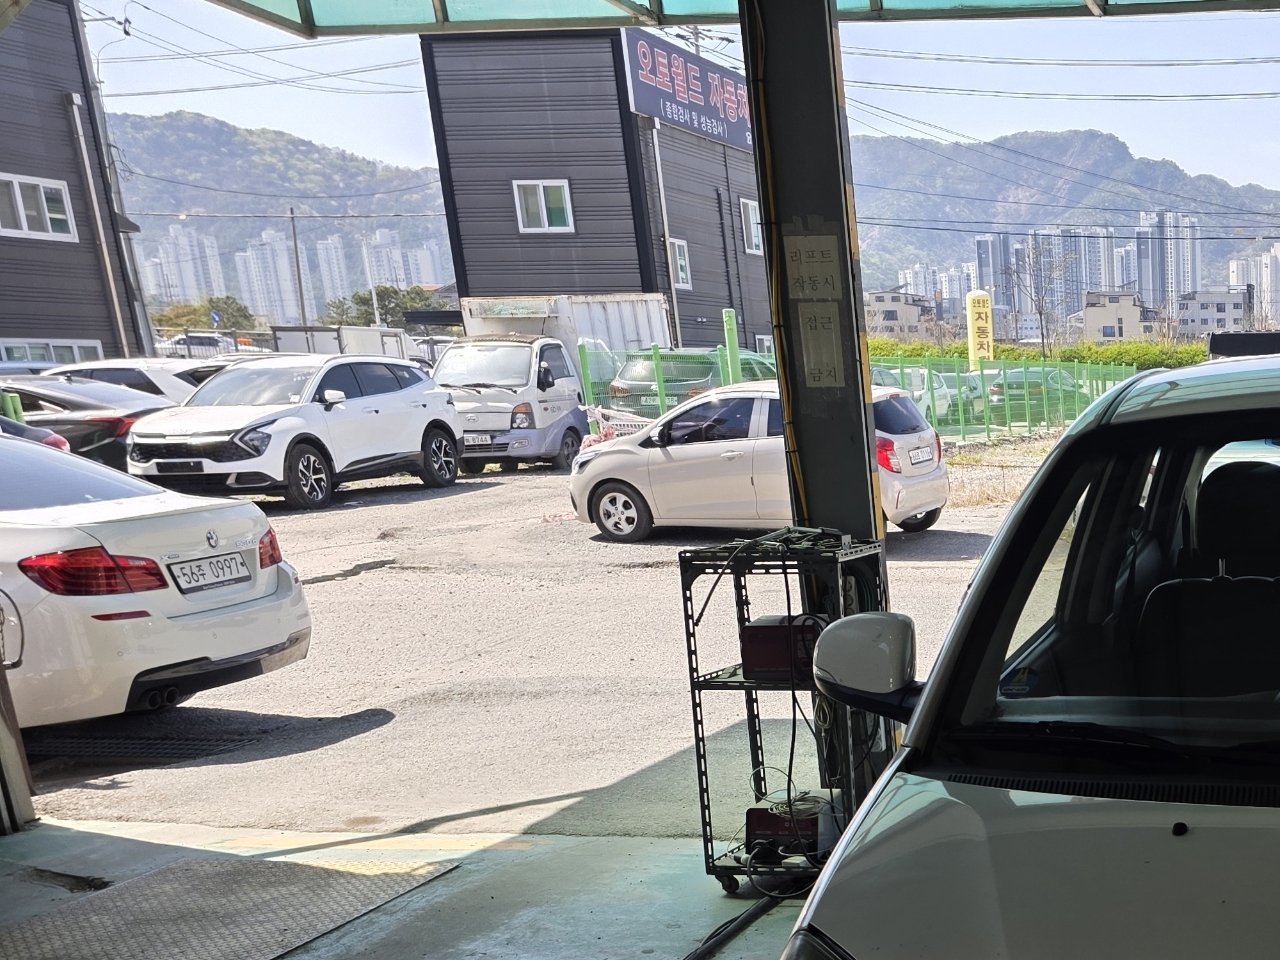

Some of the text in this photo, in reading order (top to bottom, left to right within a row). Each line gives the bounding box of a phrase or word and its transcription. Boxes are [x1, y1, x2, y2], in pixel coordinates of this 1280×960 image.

[637, 40, 704, 106] 오토월드
[691, 111, 699, 128] 및
[789, 249, 834, 266] 리프트
[792, 275, 836, 292] 작동시
[805, 315, 833, 331] 접근
[810, 367, 837, 383] 금지
[179, 564, 207, 585] 56주
[208, 557, 240, 579] 0997
